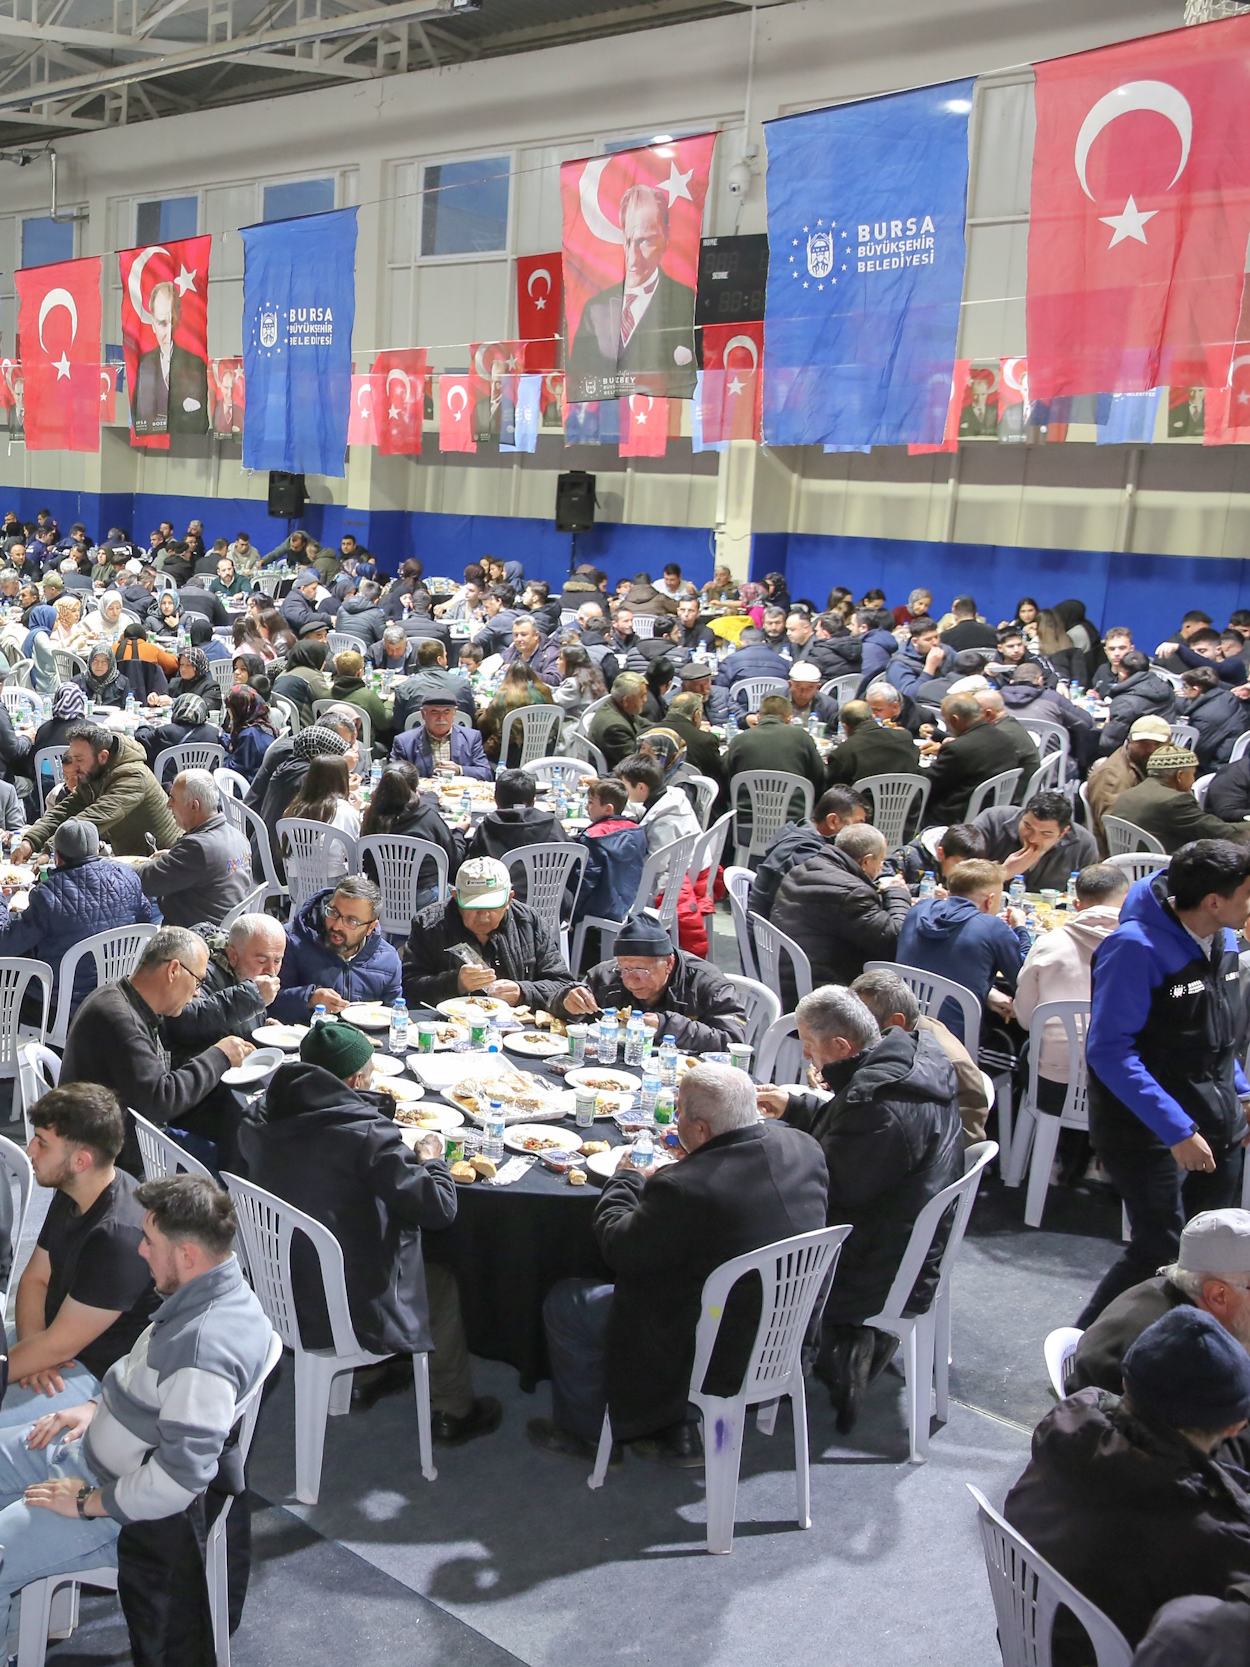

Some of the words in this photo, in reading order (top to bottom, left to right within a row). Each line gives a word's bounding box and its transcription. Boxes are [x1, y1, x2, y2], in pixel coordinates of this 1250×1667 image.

[857, 215, 935, 242] BURSA
[857, 235, 935, 257] BÜYÜKŞEHİR
[857, 250, 935, 273] BELEDİYESİ
[289, 307, 333, 322] BURSA
[289, 322, 333, 335] BÜYÜKŞEHİR
